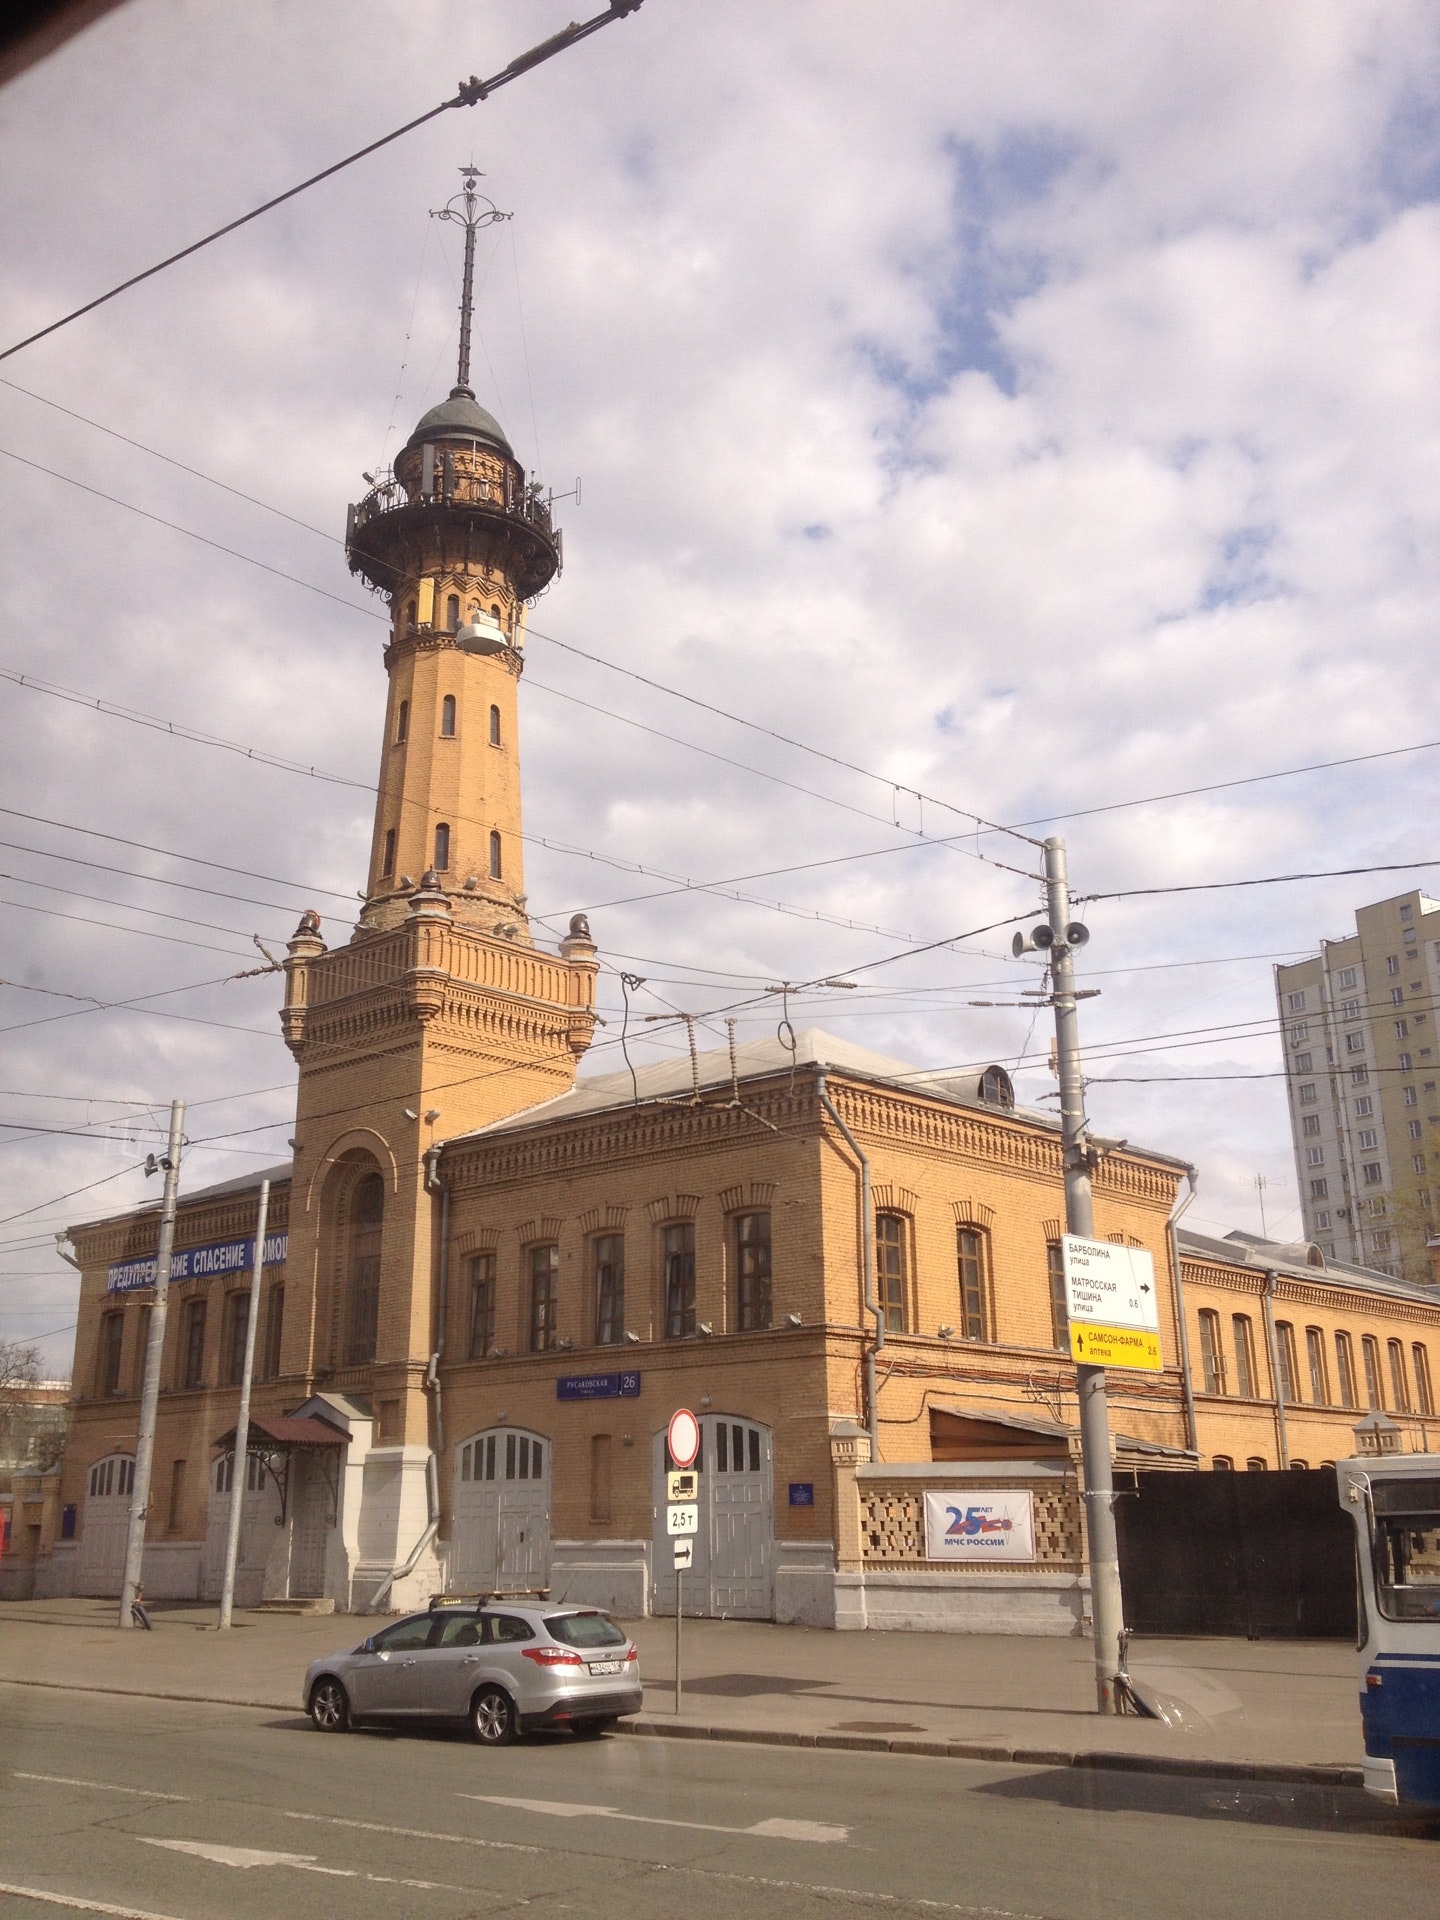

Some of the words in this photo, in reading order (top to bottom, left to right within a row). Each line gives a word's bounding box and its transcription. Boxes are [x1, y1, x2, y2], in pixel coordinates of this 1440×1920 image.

[1068, 1243, 1111, 1259] БАРБОЛИНА
[108, 1254, 188, 1289] ПРЕДУПРЕЖНИЕ
[193, 1244, 245, 1273] СПАСЕНИЕ
[1069, 1256, 1090, 1266] улица
[1071, 1276, 1117, 1292] МАТРОССКАЯ
[1072, 1289, 1102, 1303] ТИШИНА
[1073, 1302, 1094, 1313] улица
[1088, 1331, 1144, 1348] САМСОН-ФАРМА
[1089, 1347, 1112, 1357] аптека
[566, 1379, 608, 1389] РУСАКОВСКАЯ
[623, 1376, 636, 1389] 26
[672, 1512, 686, 1529] 2,5
[945, 1506, 982, 1536] 25
[944, 1538, 966, 1546] МЧС
[967, 1538, 1005, 1546] РОССИИ
